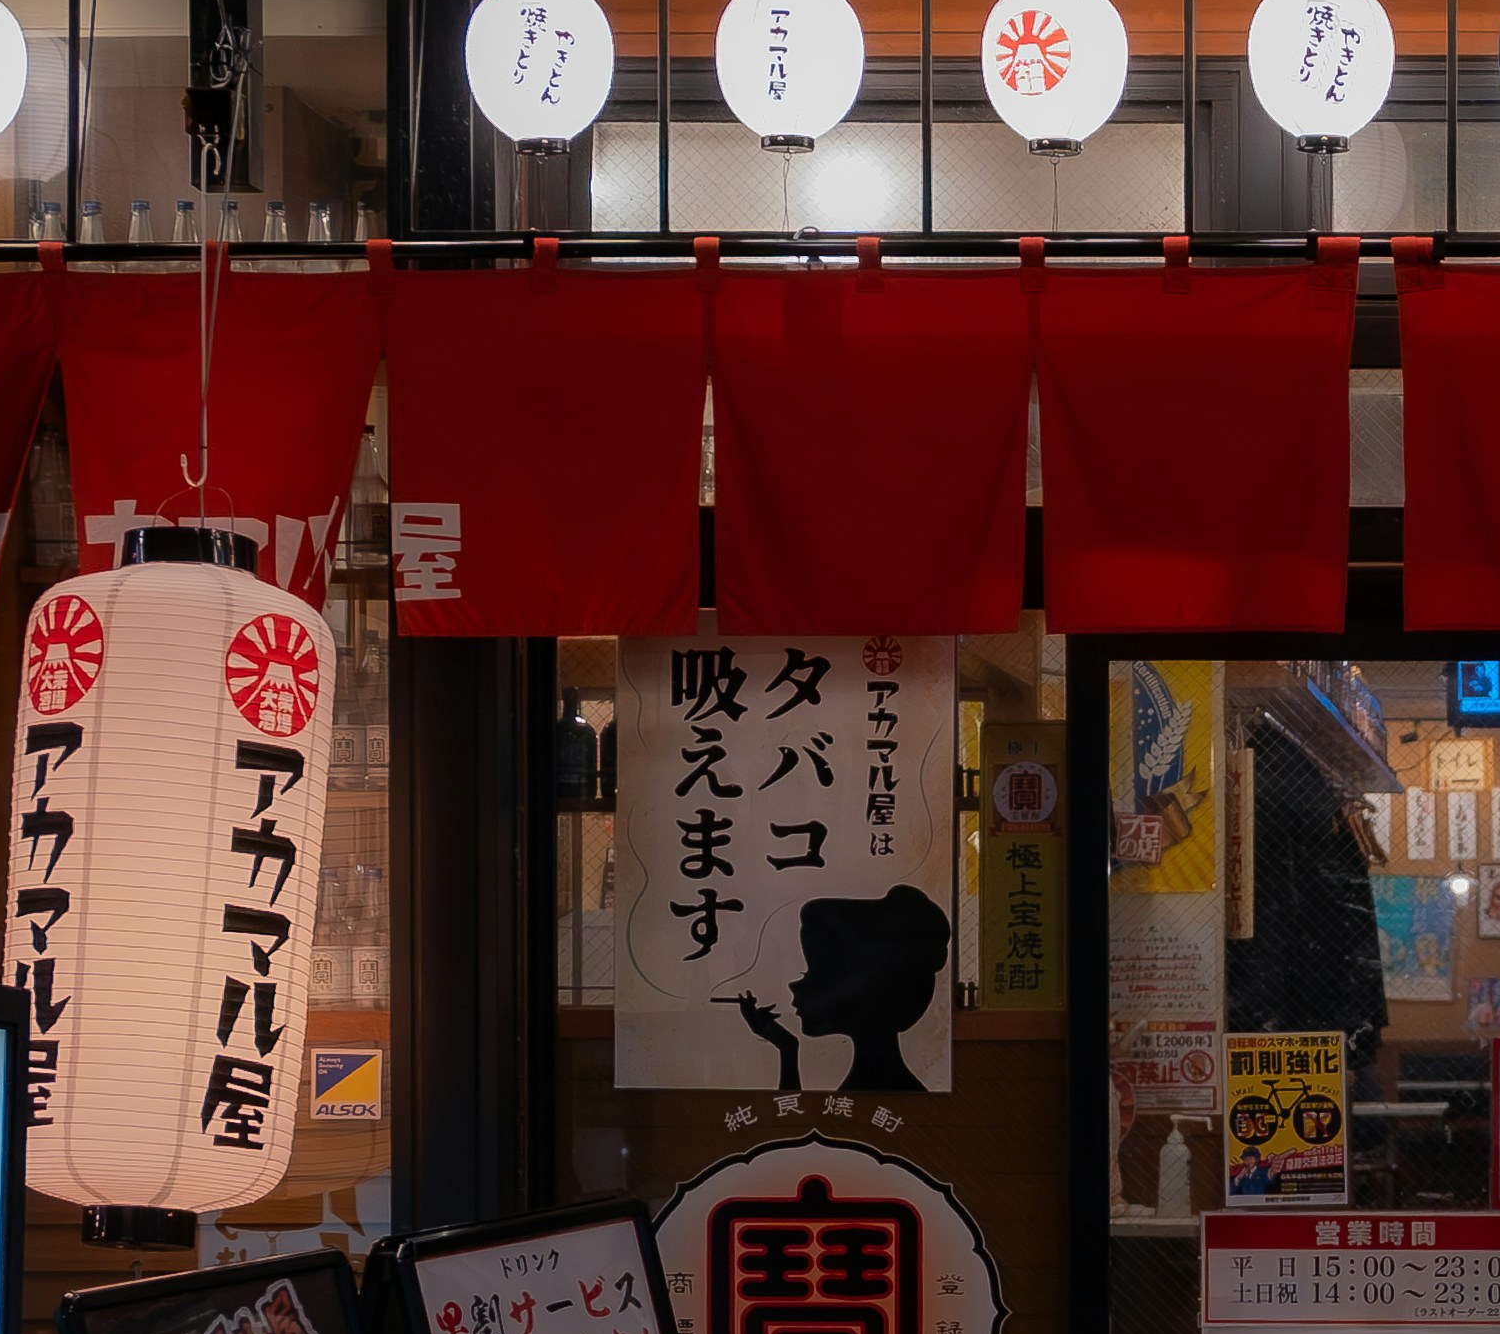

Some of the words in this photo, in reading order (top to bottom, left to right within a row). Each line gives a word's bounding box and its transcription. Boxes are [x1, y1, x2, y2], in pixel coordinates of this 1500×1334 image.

[519, 5, 549, 88] 焼きとり
[539, 28, 577, 107] やきとん
[767, 8, 791, 103] アカマル屋
[1297, 3, 1336, 85] 焼きとり
[1324, 24, 1362, 105] やきとん
[757, 646, 835, 872] タバコ
[865, 680, 901, 858] アカマル屋は
[669, 645, 749, 962] 吸えます
[15, 722, 83, 1128] アカマル屋
[200, 738, 306, 1152] アカマル屋
[1005, 841, 1045, 991] 極上宝焼酎
[1230, 1049, 1340, 1076] 罰則強化
[315, 1103, 378, 1117] ALSOK
[498, 1247, 561, 1281] ドリンク
[1315, 1220, 1437, 1247] 営業時間
[1231, 1281, 1299, 1307] 土日祝
